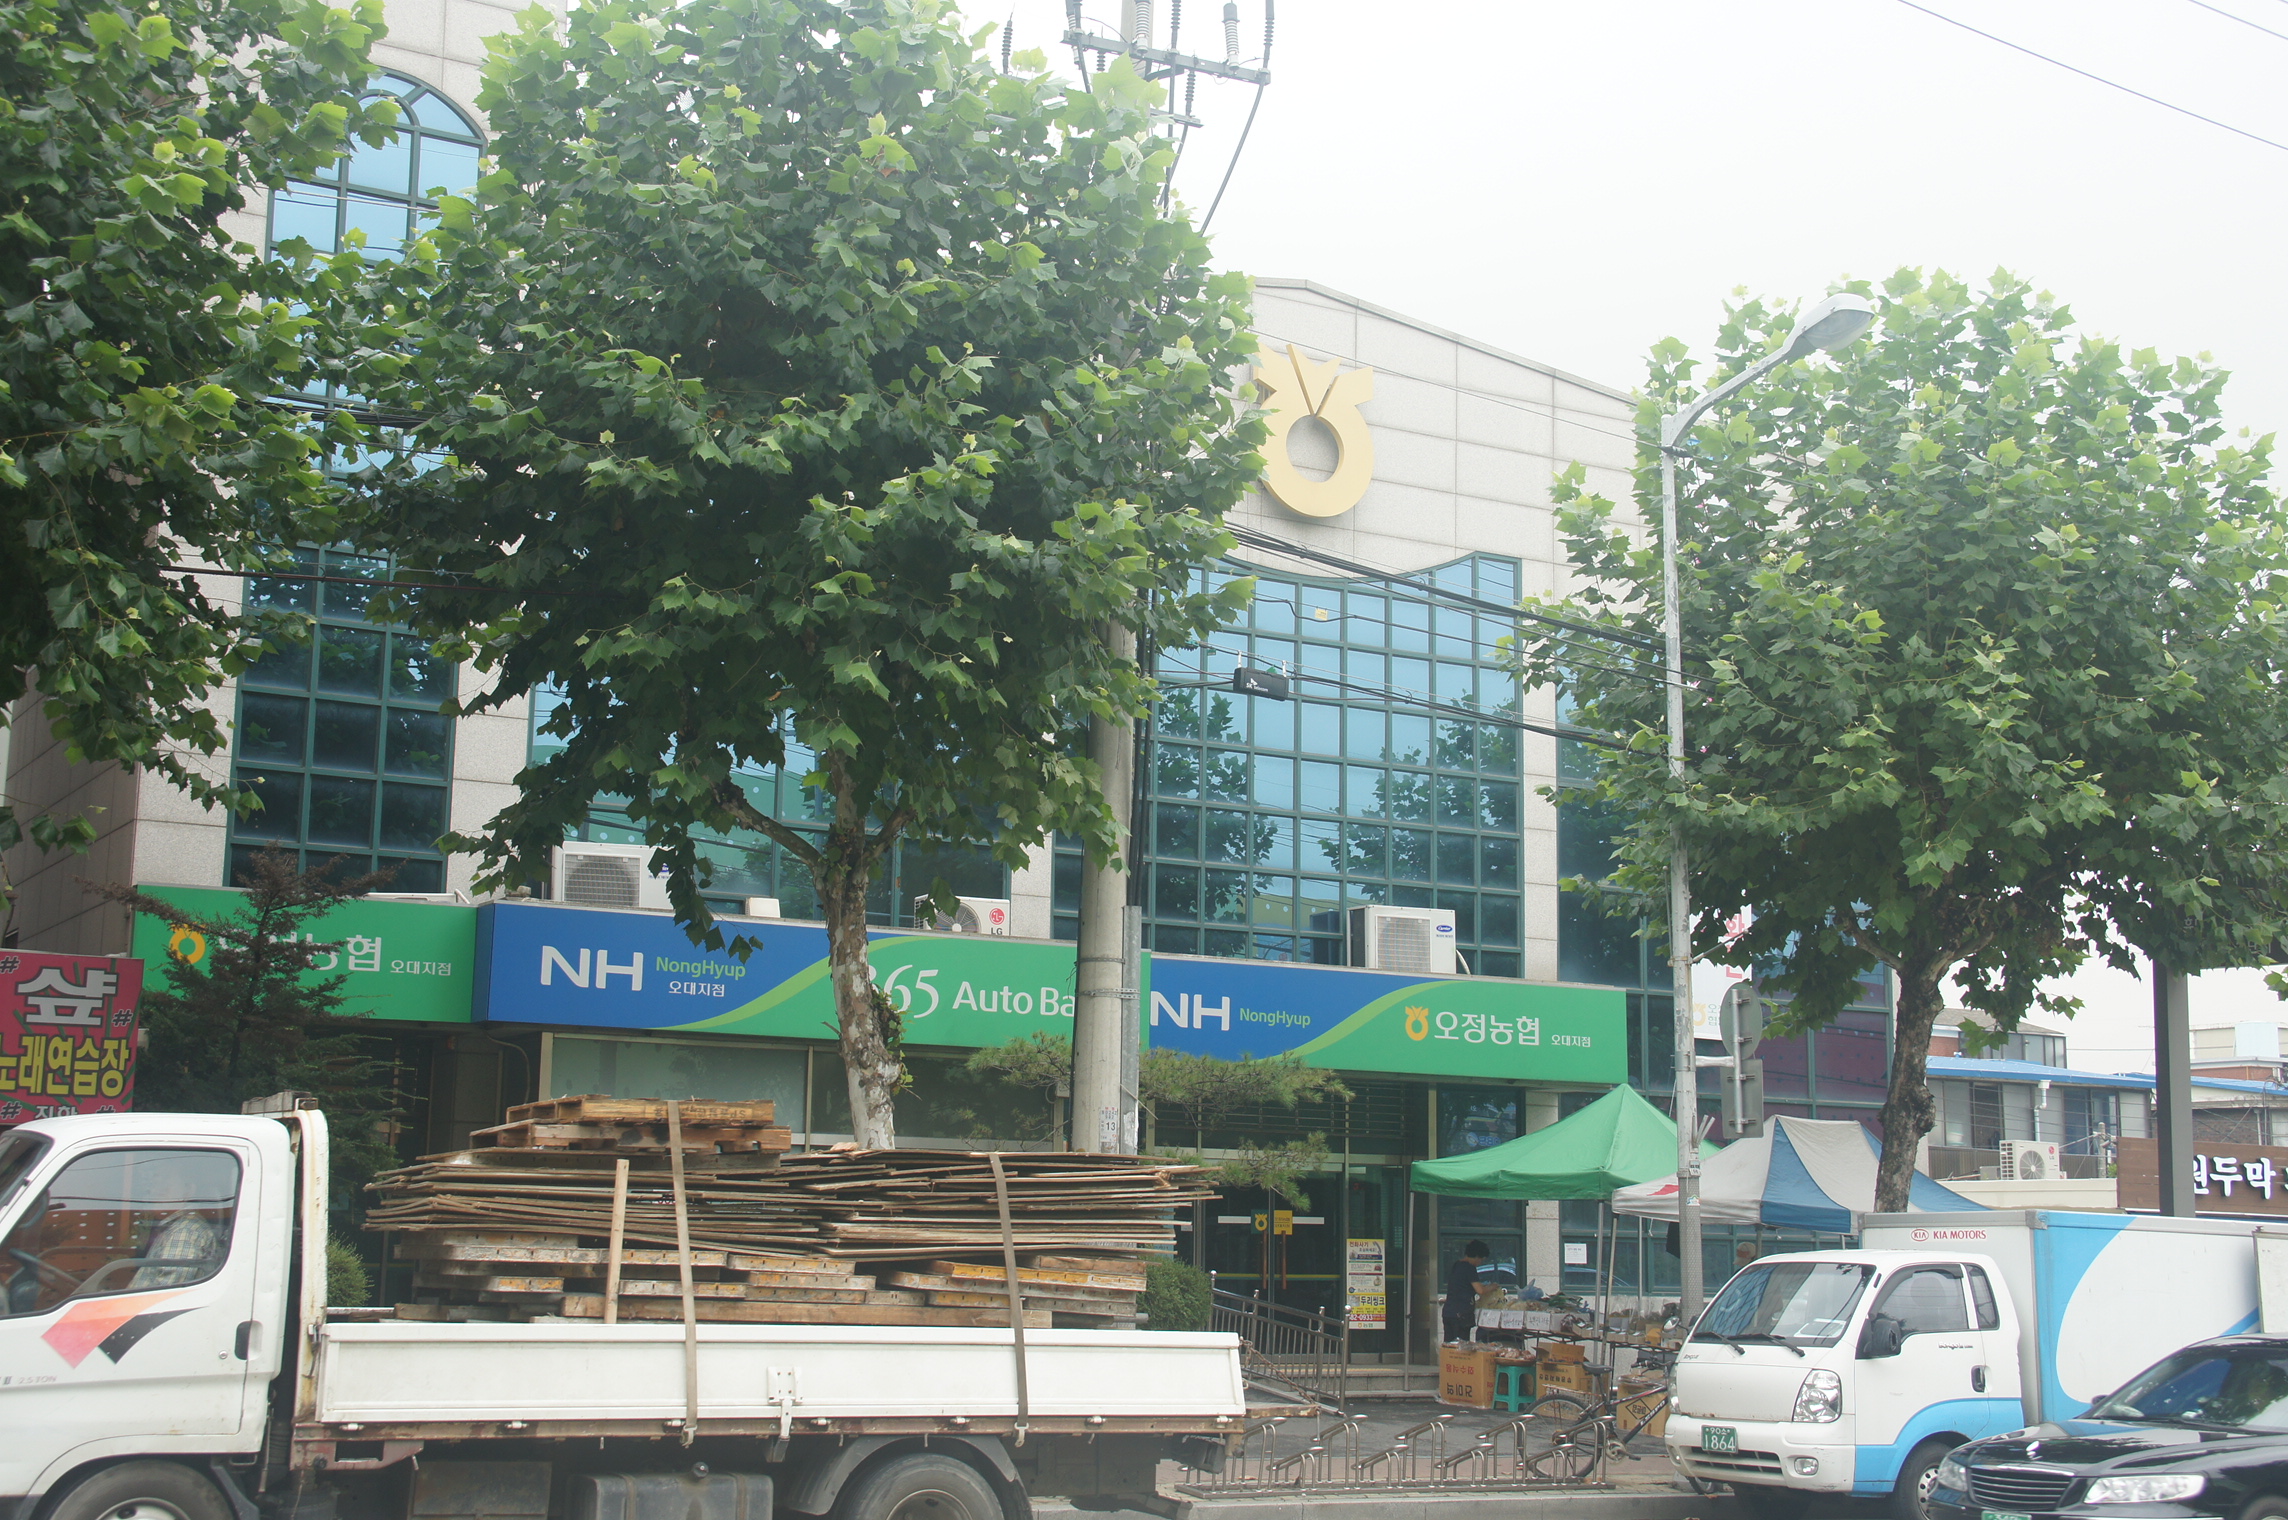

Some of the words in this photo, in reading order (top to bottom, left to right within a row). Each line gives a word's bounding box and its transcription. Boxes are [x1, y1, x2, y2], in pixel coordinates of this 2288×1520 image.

[991, 927, 1003, 935] LG
[390, 959, 452, 976] 오대지점
[541, 945, 644, 992] NH
[656, 956, 746, 981] NongHyup
[15, 966, 119, 1028] 샾
[668, 980, 725, 998] 오대지점
[952, 981, 1033, 1015] Auto
[1150, 990, 1231, 1032] NH
[1239, 1007, 1312, 1029] NongHyup
[1434, 1011, 1540, 1047] 오정농협
[1551, 1034, 1591, 1048] 오대지점
[1106, 1122, 1116, 1130] 13
[1933, 1230, 1948, 1240] KIA
[1950, 1230, 1987, 1240] MOTORS
[1705, 1434, 1736, 1451] 1864
